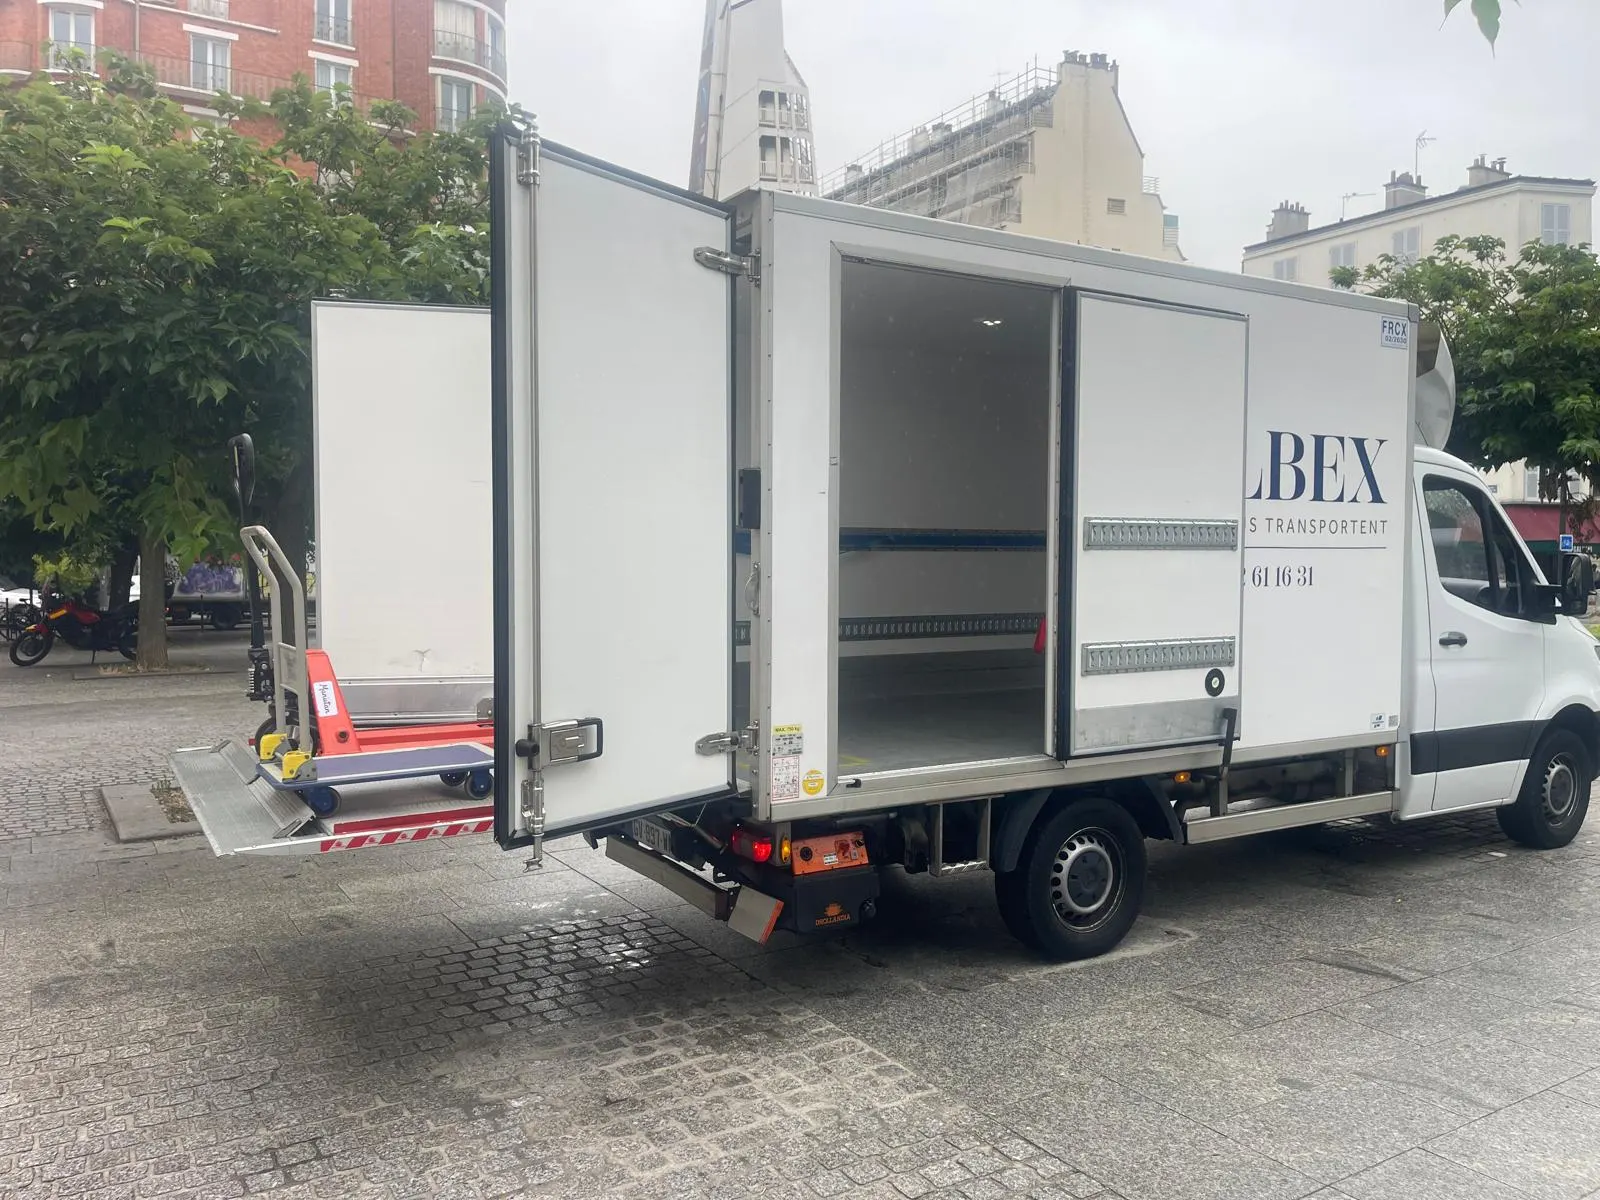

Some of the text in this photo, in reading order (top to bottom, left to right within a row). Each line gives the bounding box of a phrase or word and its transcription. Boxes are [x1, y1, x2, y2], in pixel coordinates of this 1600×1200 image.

[1382, 320, 1407, 337] FRCX
[1249, 517, 1388, 534] S TRANSPORTENT
[1252, 565, 1268, 587] 61
[1275, 565, 1291, 587] 16
[1297, 565, 1313, 587] 31
